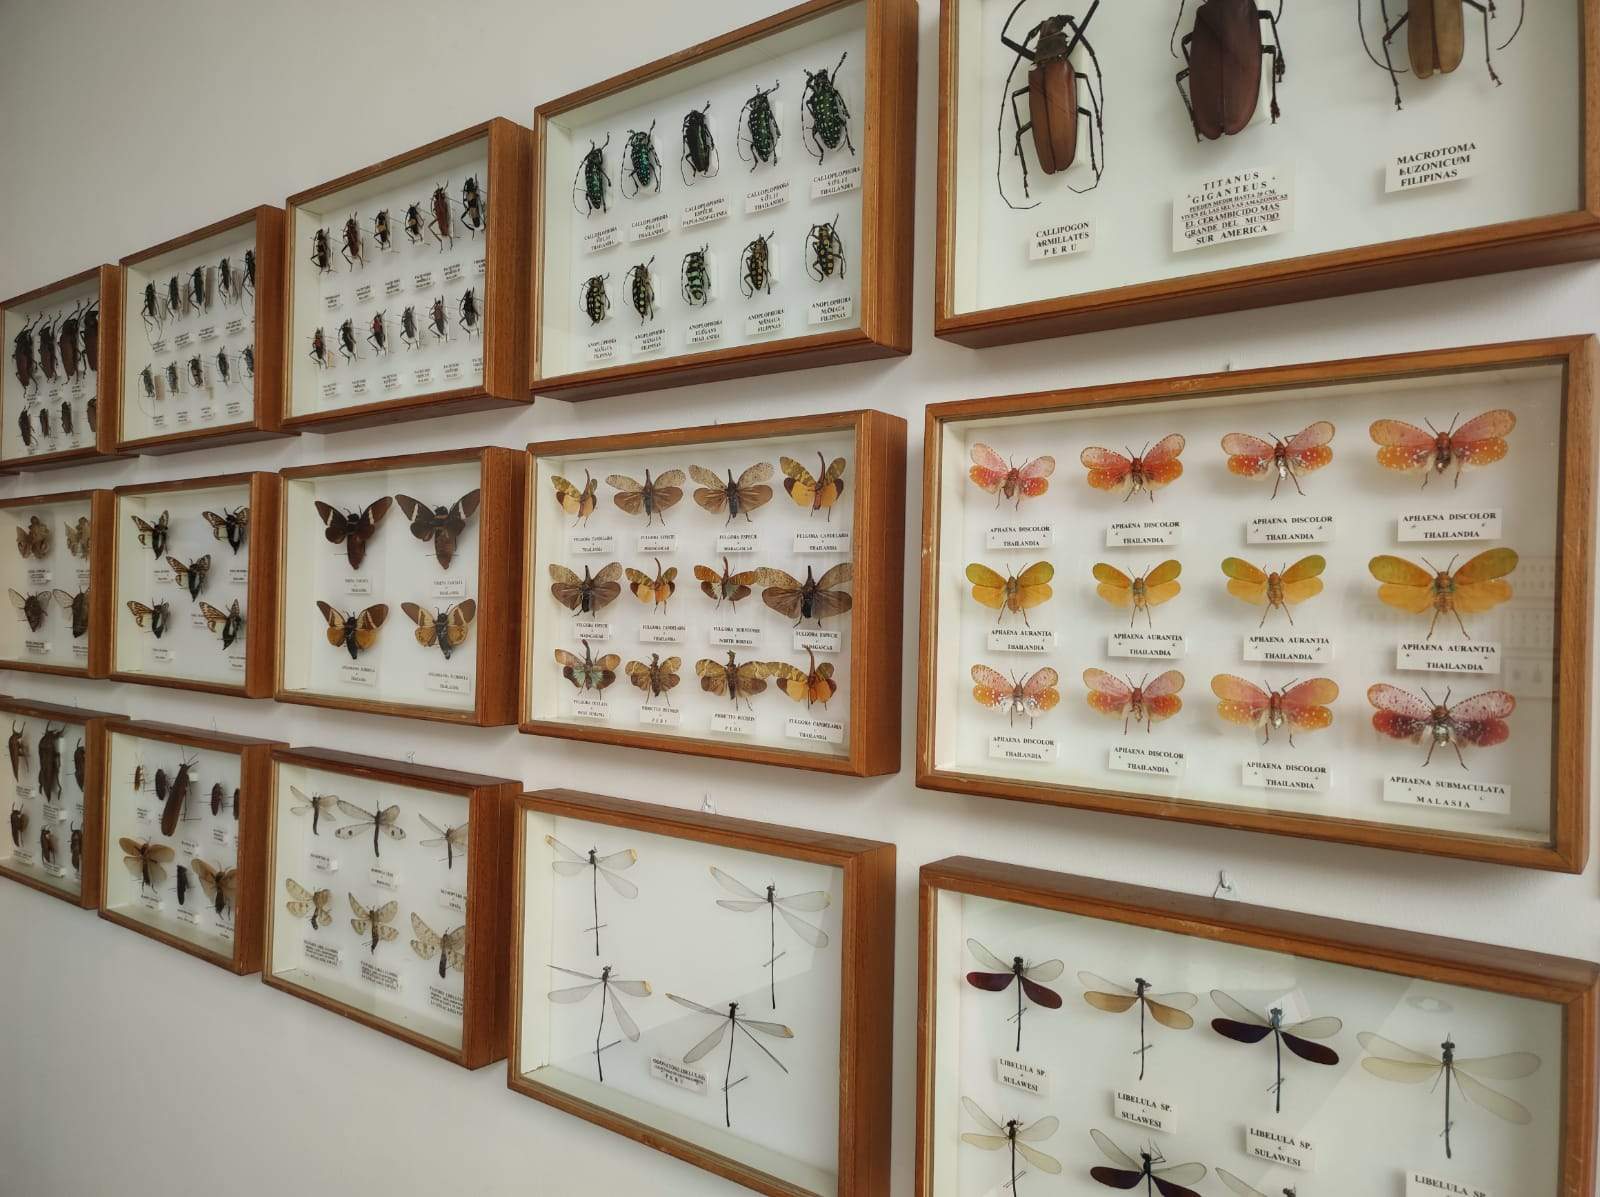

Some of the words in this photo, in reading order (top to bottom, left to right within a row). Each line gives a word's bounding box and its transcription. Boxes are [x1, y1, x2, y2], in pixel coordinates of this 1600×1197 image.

[1397, 142, 1476, 165] MACROTOMA
[1203, 172, 1259, 191] TITANUS
[1401, 169, 1458, 186] FILIPINAS
[1192, 182, 1267, 204] GIGANTEUS
[1213, 198, 1232, 206] MEDIR
[1234, 194, 1254, 202] HASTA
[1186, 221, 1194, 230] EL
[1198, 208, 1258, 226] CERAMBICIDO
[1260, 203, 1280, 211] MAS
[1036, 222, 1089, 238] CALLIPOGON
[1184, 224, 1217, 238] GRANDE
[1222, 220, 1238, 229] DEL
[1246, 212, 1279, 224] MUNDO
[1036, 232, 1089, 248] ARMILLATUS
[1196, 234, 1214, 245] SUR
[1221, 225, 1268, 240] AMERICA
[1044, 244, 1077, 256] PERU
[1291, 516, 1333, 524] DISCOLOR
[1403, 514, 1444, 522] APHAENA
[1449, 512, 1496, 520] DISCOLOR
[1424, 530, 1480, 538] THAILANDIA
[1114, 632, 1144, 640] APHAENA
[1264, 652, 1312, 660] THAILANDIA
[1402, 644, 1443, 652] APHAENA
[1448, 644, 1495, 654] AURANTIA
[1426, 662, 1483, 671] THAILANDIA
[1024, 738, 1054, 746] DISCOLOR
[1006, 752, 1042, 760] THAILANDIA
[1114, 746, 1145, 756] APHAENA
[1148, 750, 1184, 759] DISCOLOR
[1128, 763, 1170, 774] THAILANDIA
[1246, 762, 1282, 770] APHAENA
[1286, 764, 1326, 774] DISCOLOR
[1266, 778, 1314, 790] THAILANDIA
[1390, 776, 1432, 786] APHAENA
[1436, 780, 1505, 794] SUBMACULATA
[1416, 796, 1470, 808] MALASIA
[1000, 1058, 1034, 1074] LIBELULA
[1036, 1068, 1046, 1077] SP.
[1004, 1076, 1038, 1092] SULAWESI
[1118, 1092, 1157, 1108] LIBELULA
[1160, 1103, 1172, 1112] SP.
[1122, 1111, 1162, 1128] SULAWESI
[1250, 1128, 1296, 1146] LIBELULA
[1300, 1140, 1312, 1150] SP.
[1254, 1147, 1301, 1166] SULAWESI
[1415, 1174, 1468, 1196] LIBELULA
